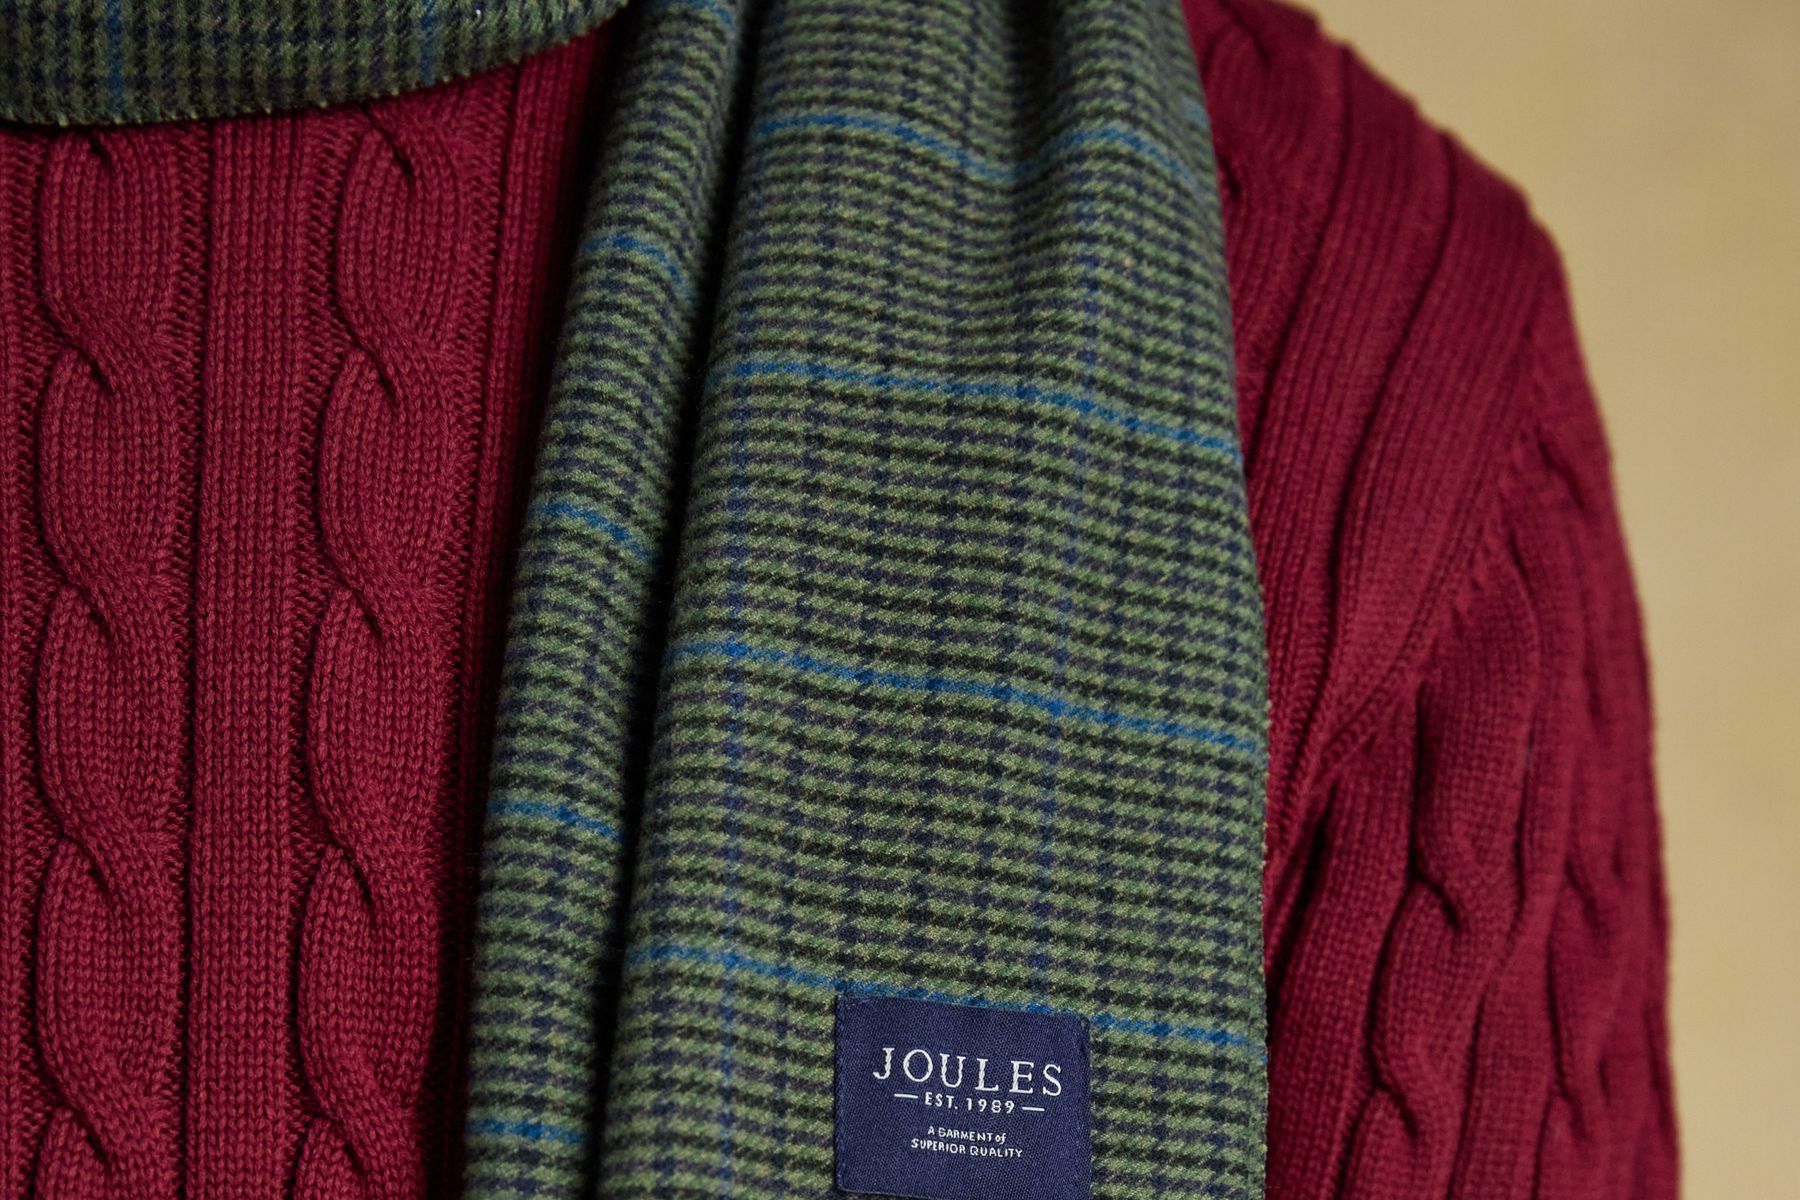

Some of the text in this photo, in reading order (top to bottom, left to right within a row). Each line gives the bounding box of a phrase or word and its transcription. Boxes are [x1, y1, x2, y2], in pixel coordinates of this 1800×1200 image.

[872, 1047, 1062, 1096] JOULES
[925, 1091, 1015, 1114] EST. 1989
[927, 1126, 1007, 1144] A GARMENT of
[911, 1138, 1023, 1158] SUPERIOR QUALITY
